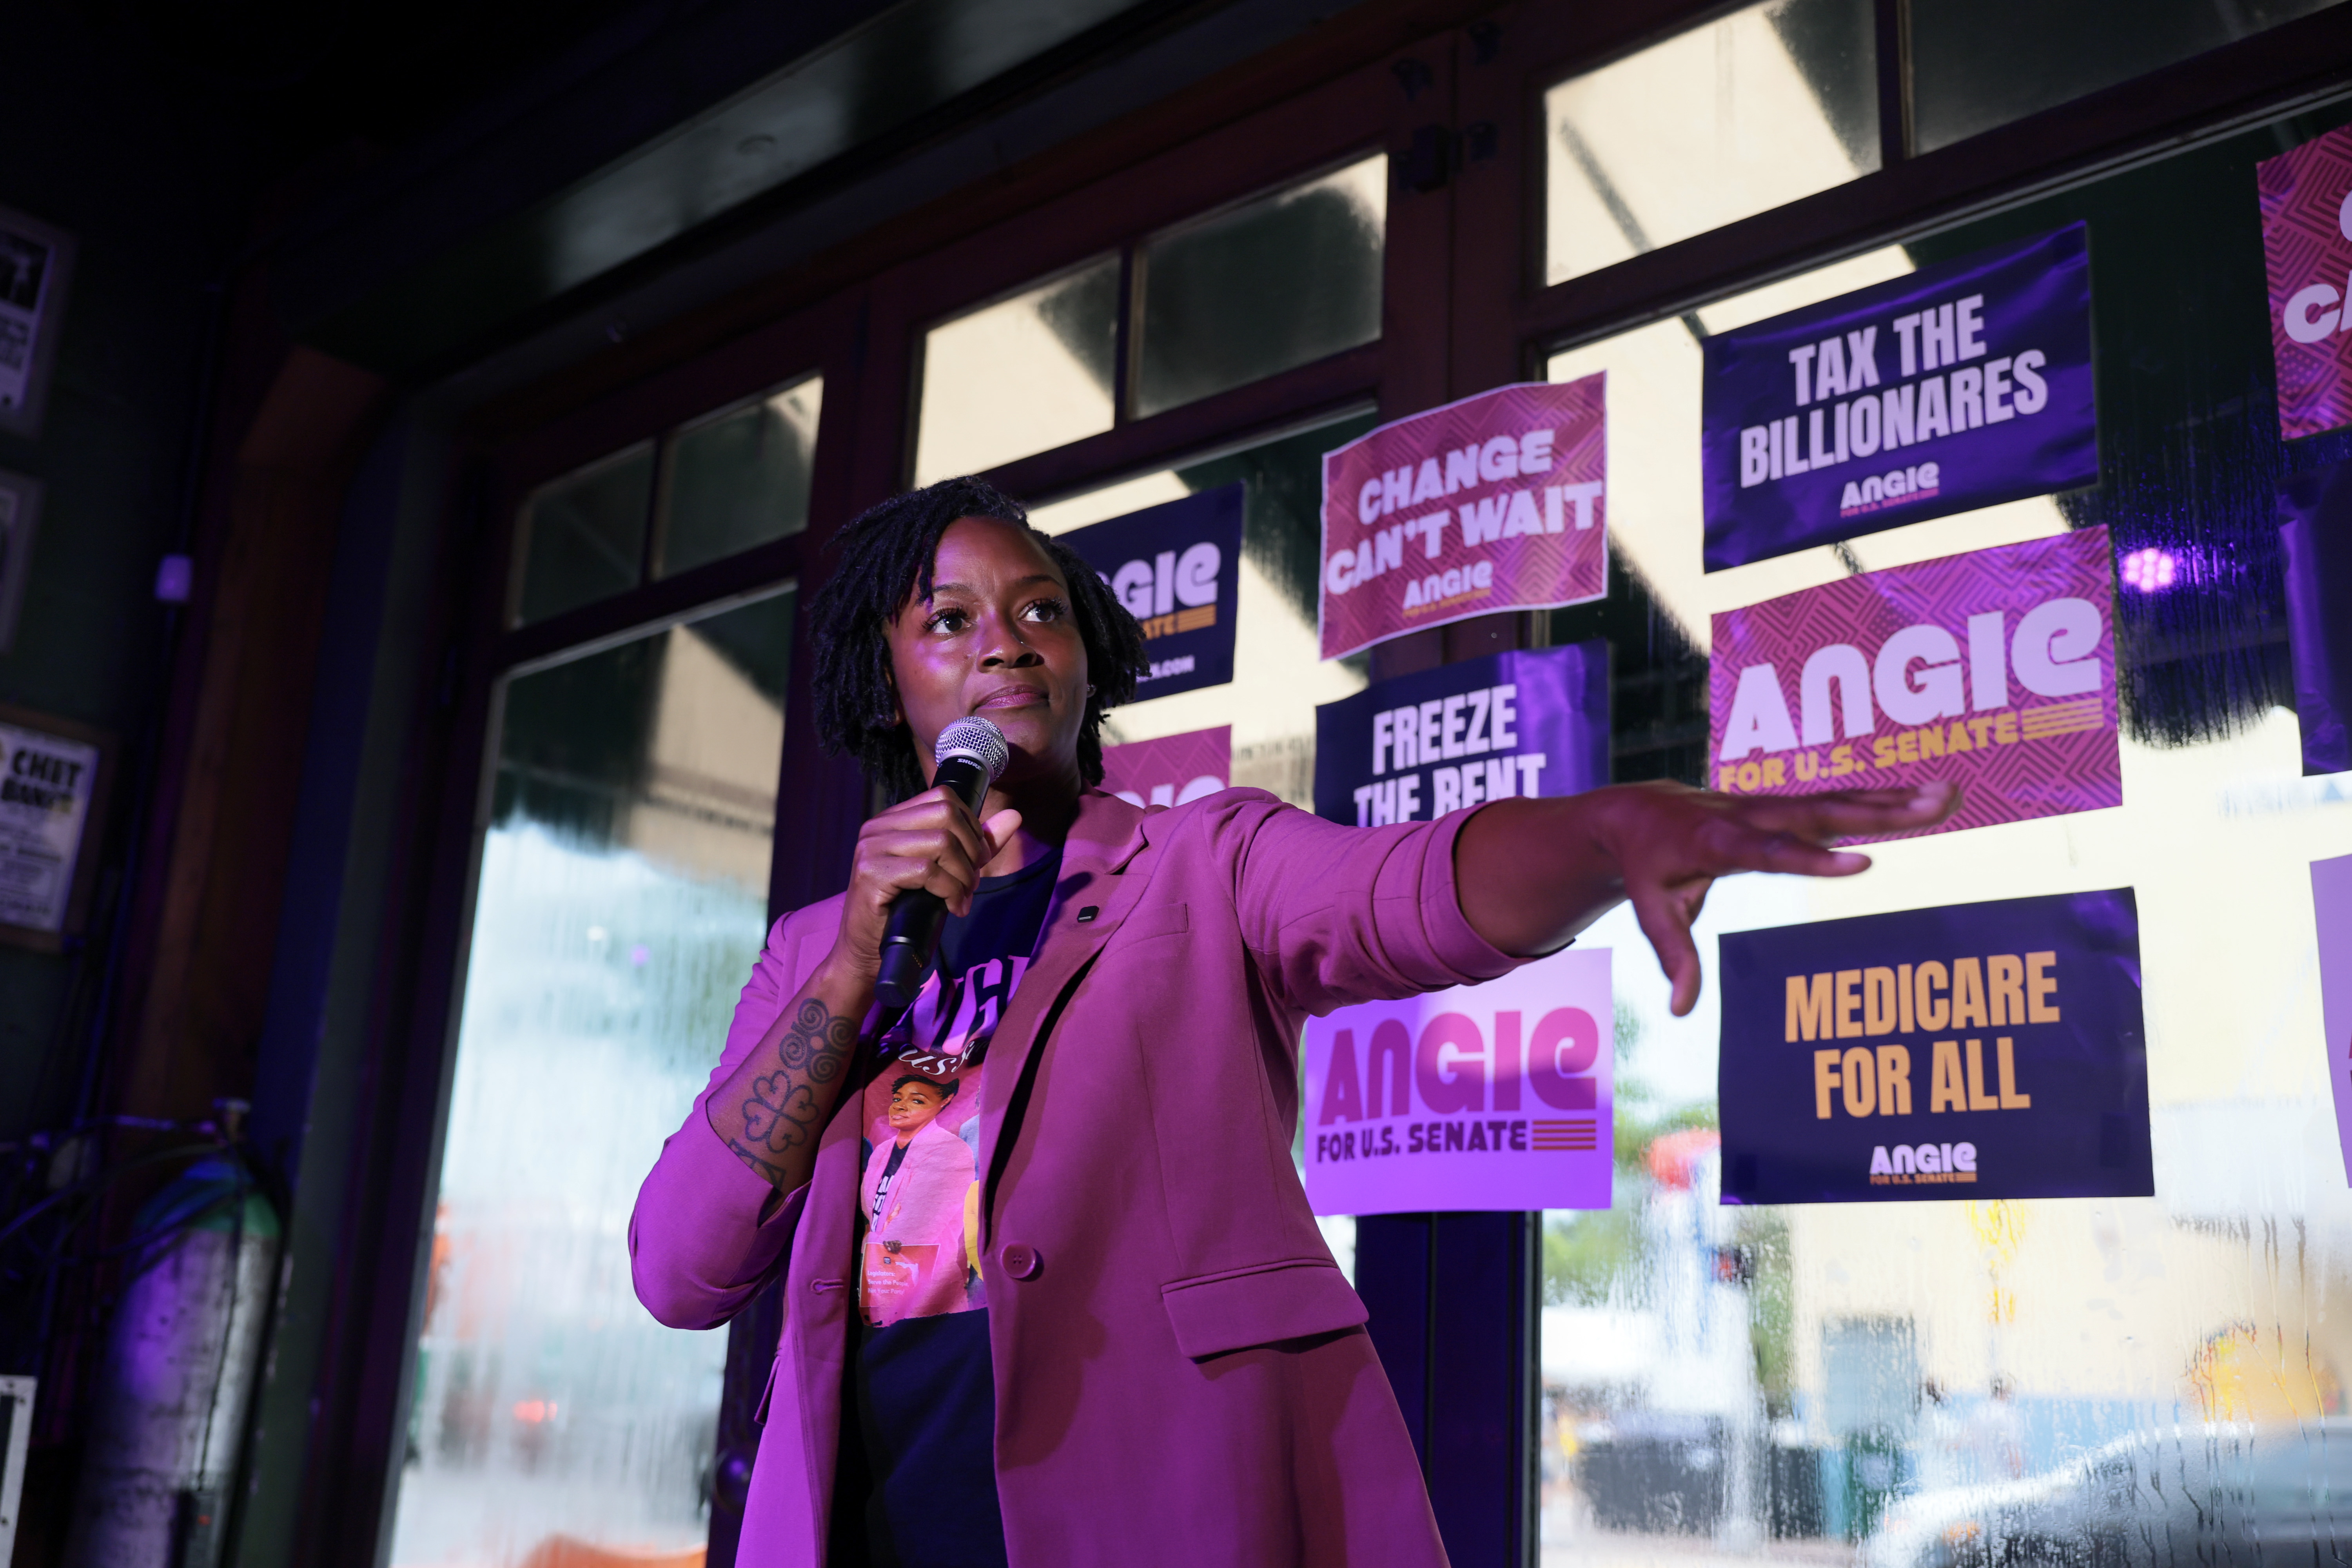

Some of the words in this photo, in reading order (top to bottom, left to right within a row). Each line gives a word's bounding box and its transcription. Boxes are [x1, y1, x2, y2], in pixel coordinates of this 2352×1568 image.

[1789, 325, 1880, 407] TAX
[1893, 293, 1987, 377] THE
[1740, 349, 2048, 488] BILLIONARES
[1358, 429, 1554, 525] CHANGE
[1327, 511, 1450, 594] CAN'T
[1459, 479, 1603, 547] WAIT
[957, 758, 982, 771] SHURE
[1372, 684, 1517, 776] FREEZE
[1719, 758, 1786, 793] FOR
[1795, 744, 1866, 782] U.S.
[1873, 711, 2018, 769] SENATE
[1354, 774, 1420, 828] THE
[1432, 753, 1546, 821] RENT
[1785, 951, 2060, 1043] MEDICARE
[1814, 1044, 1912, 1120] FOR
[1931, 1036, 2031, 1114] ALL
[1317, 1132, 1355, 1163] FOR
[1361, 1125, 1400, 1158] U.S.
[1408, 1120, 1527, 1153] SENATE
